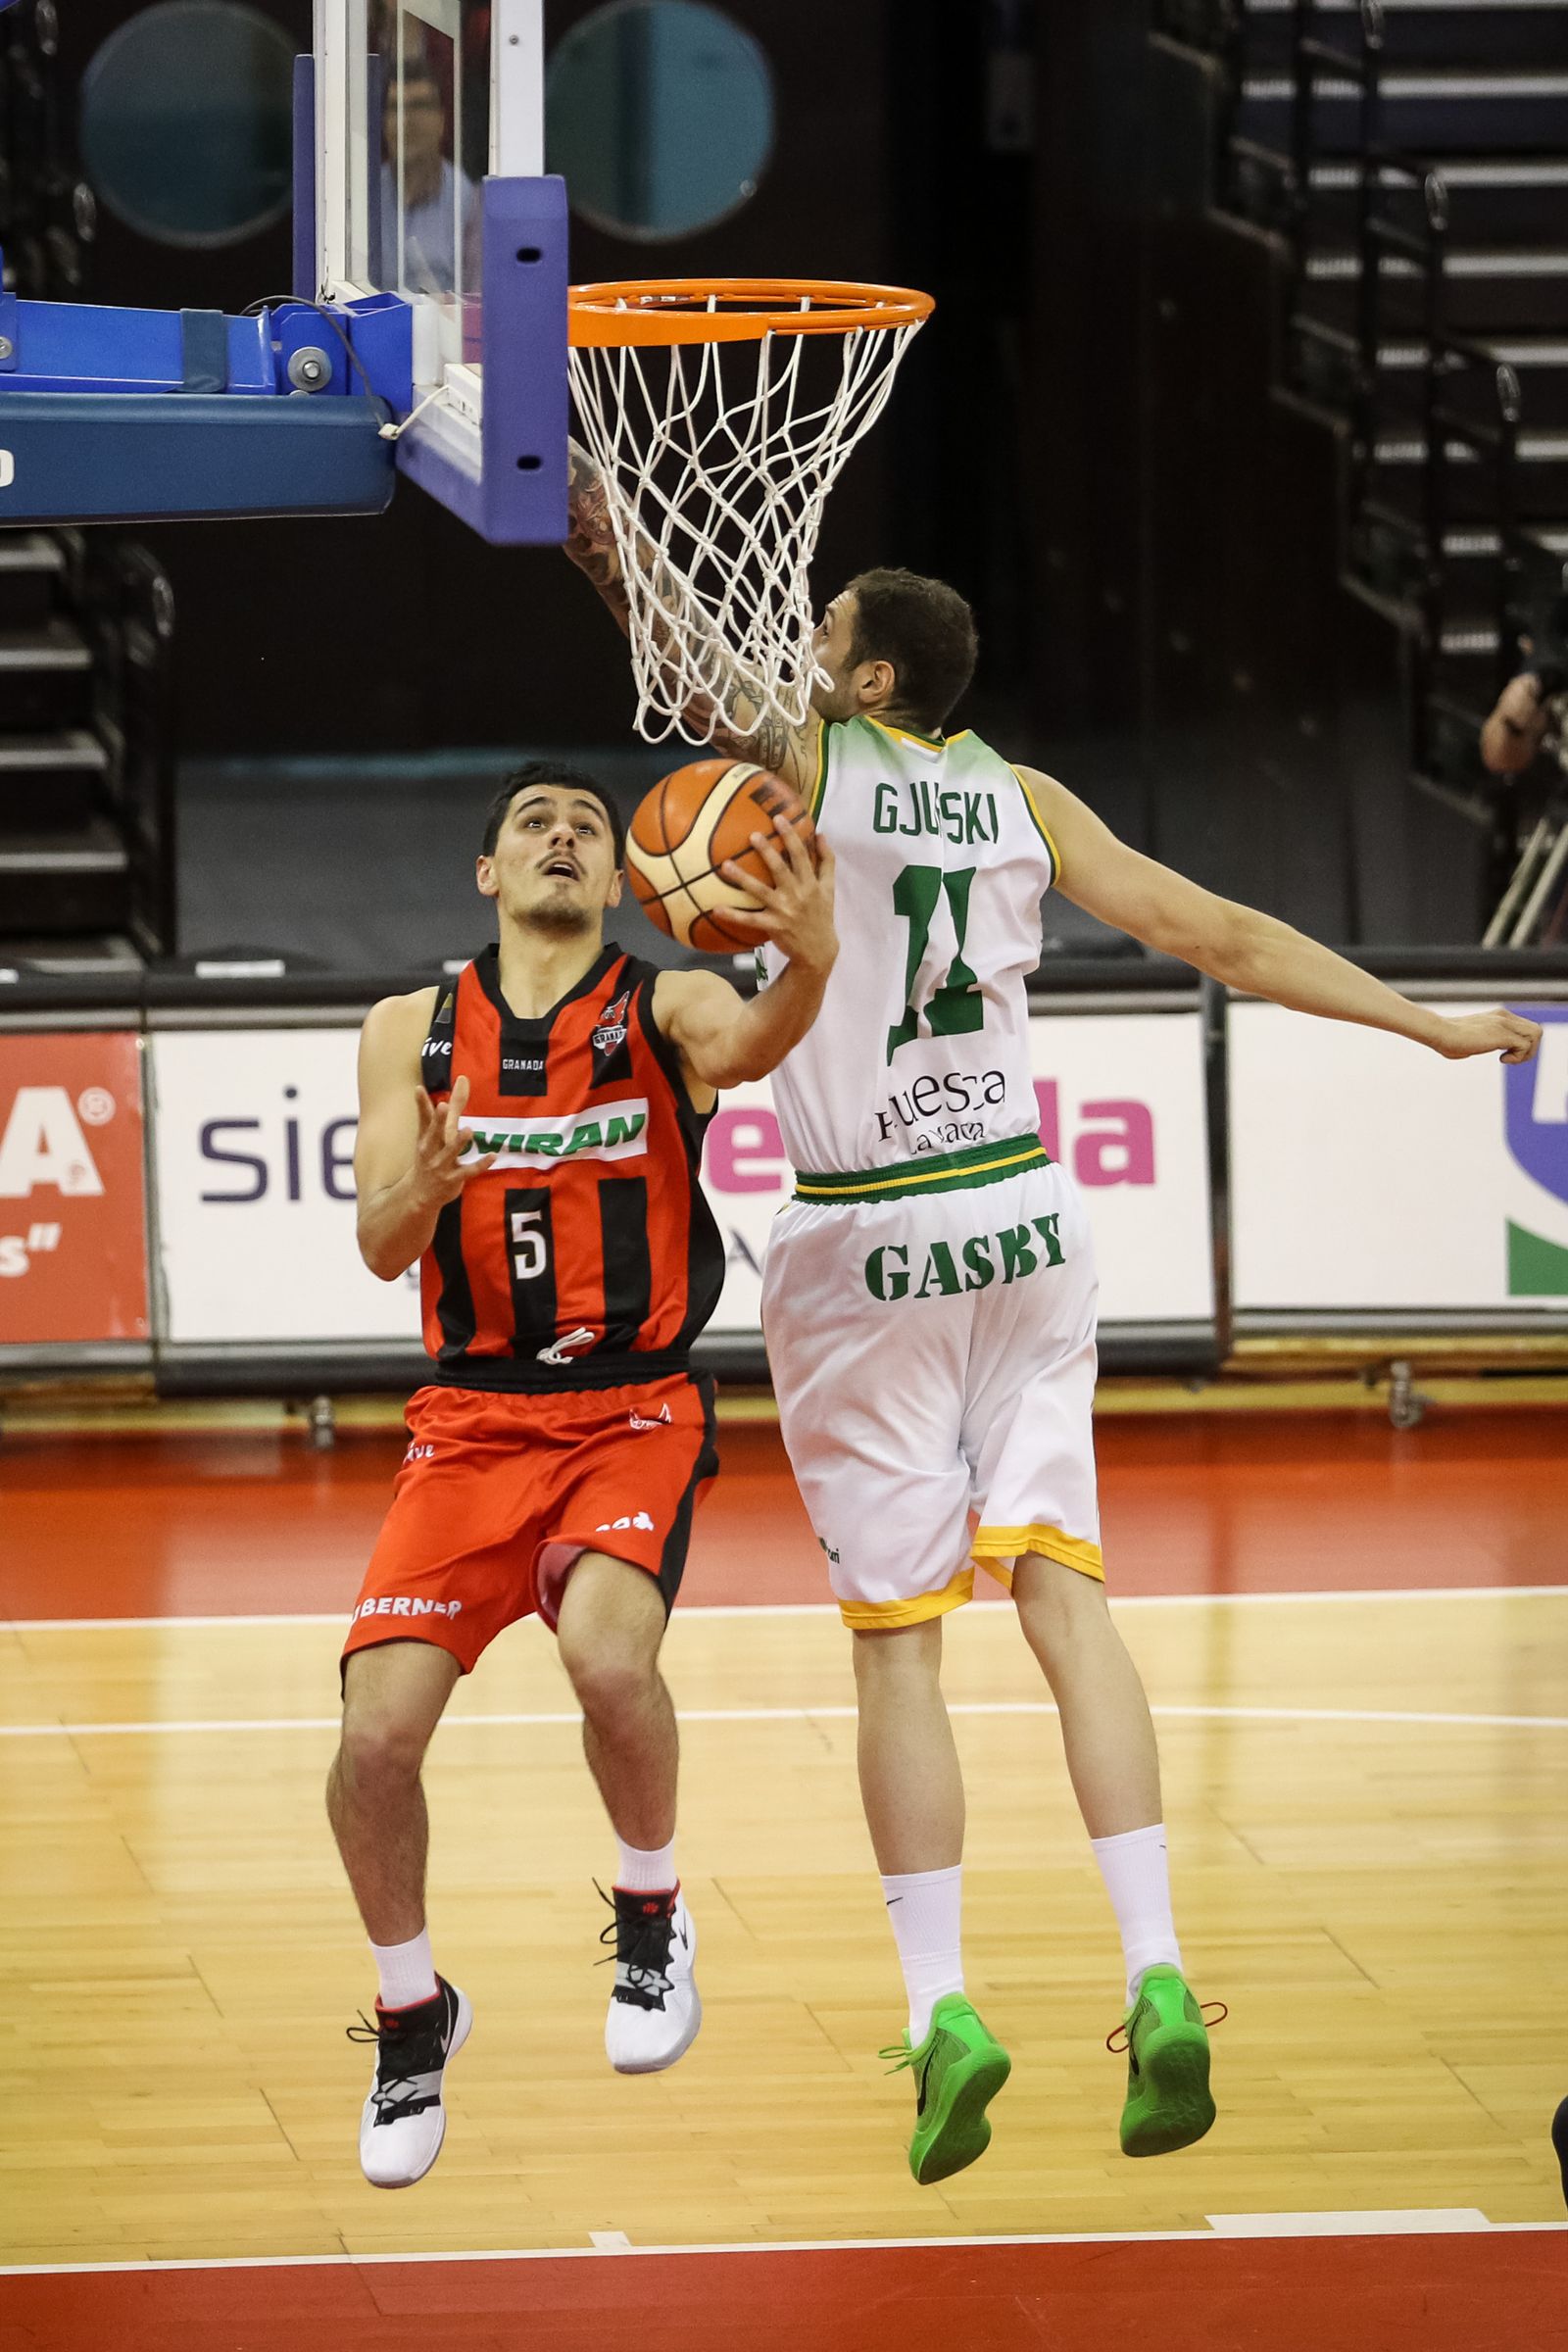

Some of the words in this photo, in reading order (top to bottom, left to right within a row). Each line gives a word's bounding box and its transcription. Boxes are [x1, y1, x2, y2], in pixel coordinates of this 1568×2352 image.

[503, 1058, 544, 1070] GRANADA
[511, 1210, 547, 1279] 5
[864, 1212, 1066, 1301] GASBY
